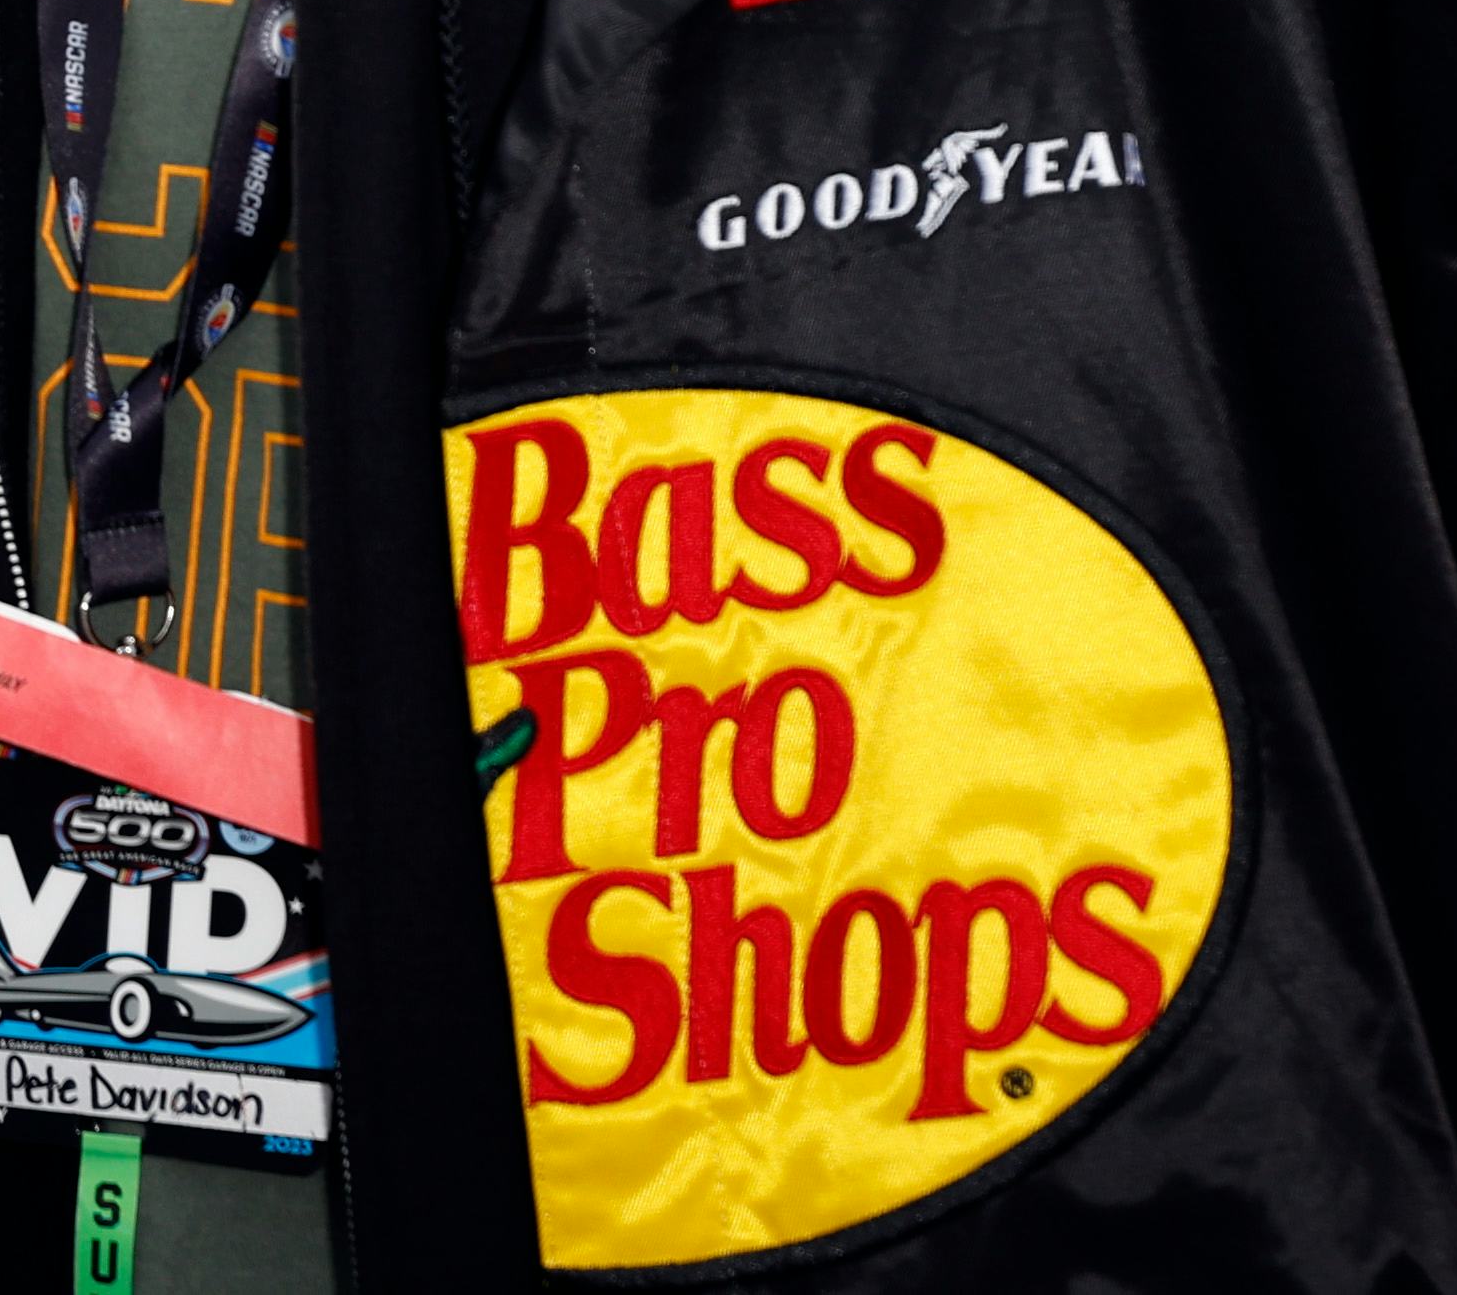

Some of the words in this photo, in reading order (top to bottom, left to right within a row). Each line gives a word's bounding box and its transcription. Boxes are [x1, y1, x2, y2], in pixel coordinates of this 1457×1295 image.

[66, 20, 89, 105] NASCAR
[234, 146, 273, 238] NASCAR
[461, 418, 945, 667] Bass
[95, 795, 171, 817] DAYTONA
[494, 650, 854, 885] Pro
[68, 809, 196, 851] 500
[525, 862, 1163, 1122] Shops
[5, 1055, 78, 1106] Pete
[90, 1064, 264, 1126] Davidson
[261, 1135, 315, 1156] 2023
